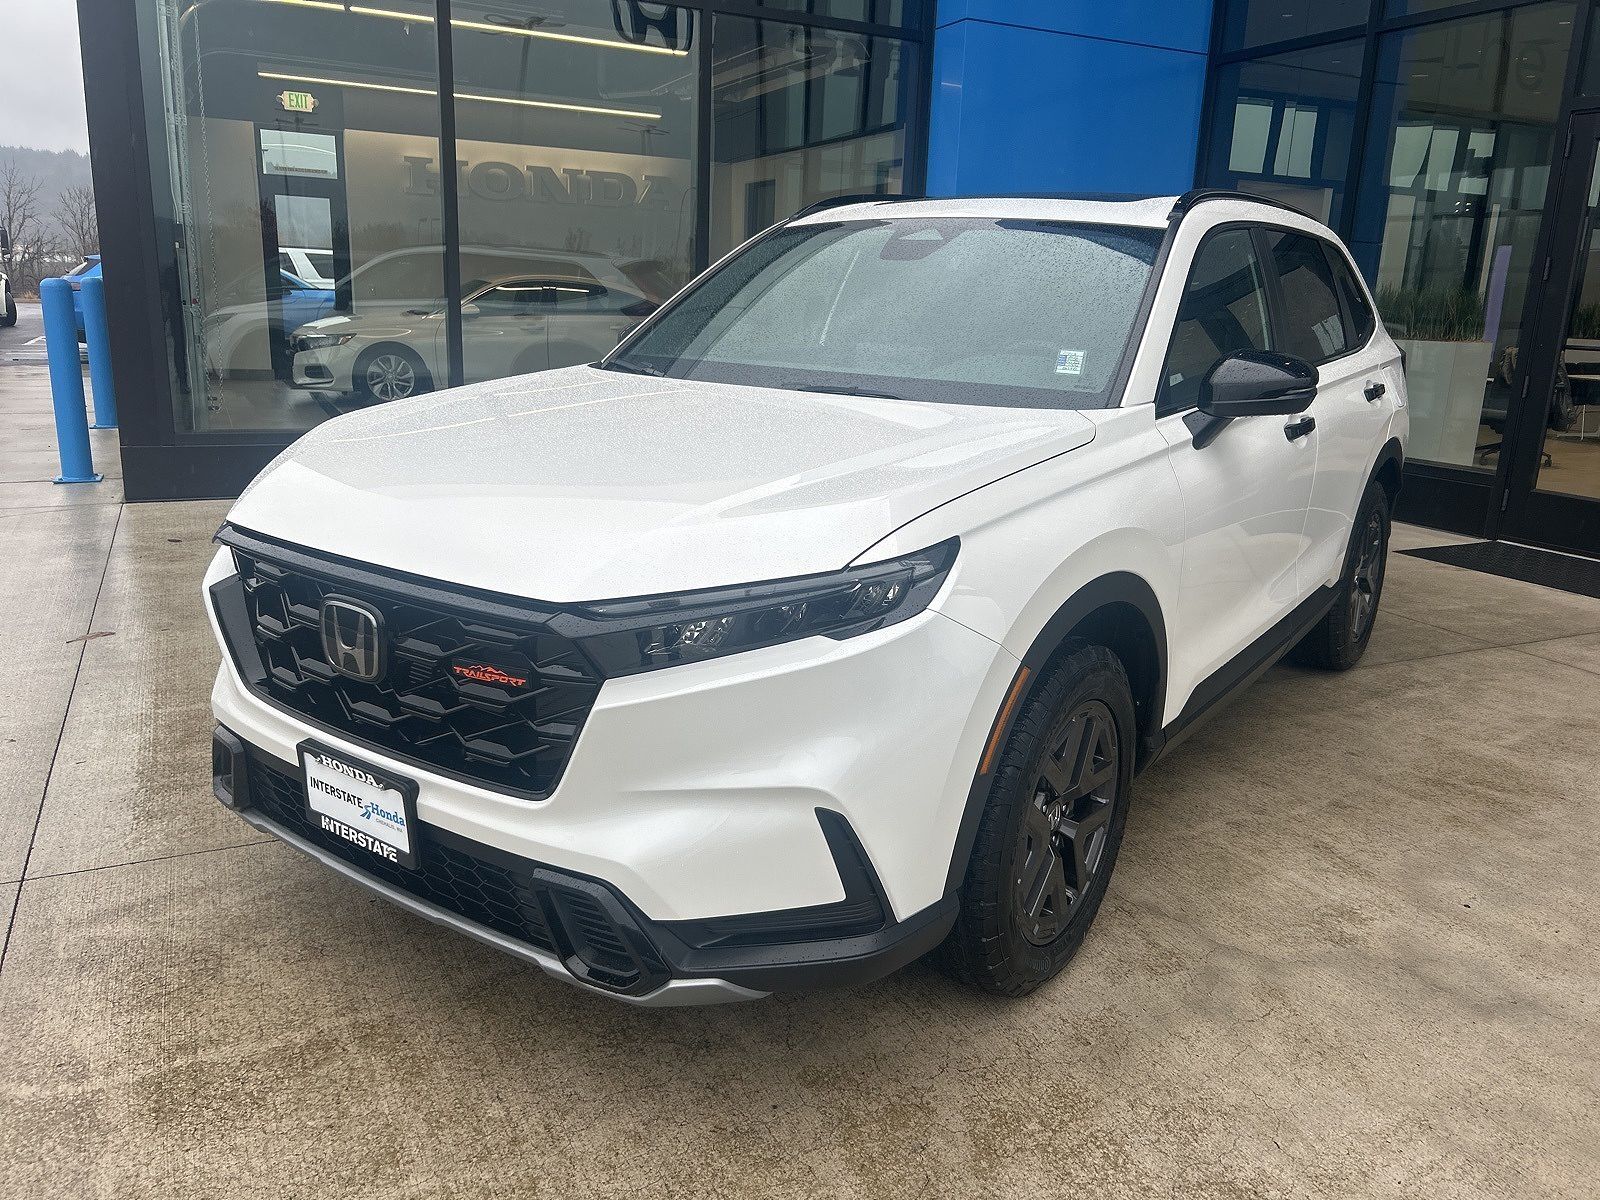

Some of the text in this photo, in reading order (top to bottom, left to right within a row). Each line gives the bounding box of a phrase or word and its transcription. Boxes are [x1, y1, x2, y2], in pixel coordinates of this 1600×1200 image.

[288, 92, 309, 109] EXIT
[403, 156, 674, 212] HONDA
[453, 666, 526, 686] TRAILSPORT
[320, 755, 379, 788] HONDA
[310, 776, 364, 809] INTERSTATE
[370, 802, 405, 826] Honda
[321, 815, 398, 862] INTERSTATE
